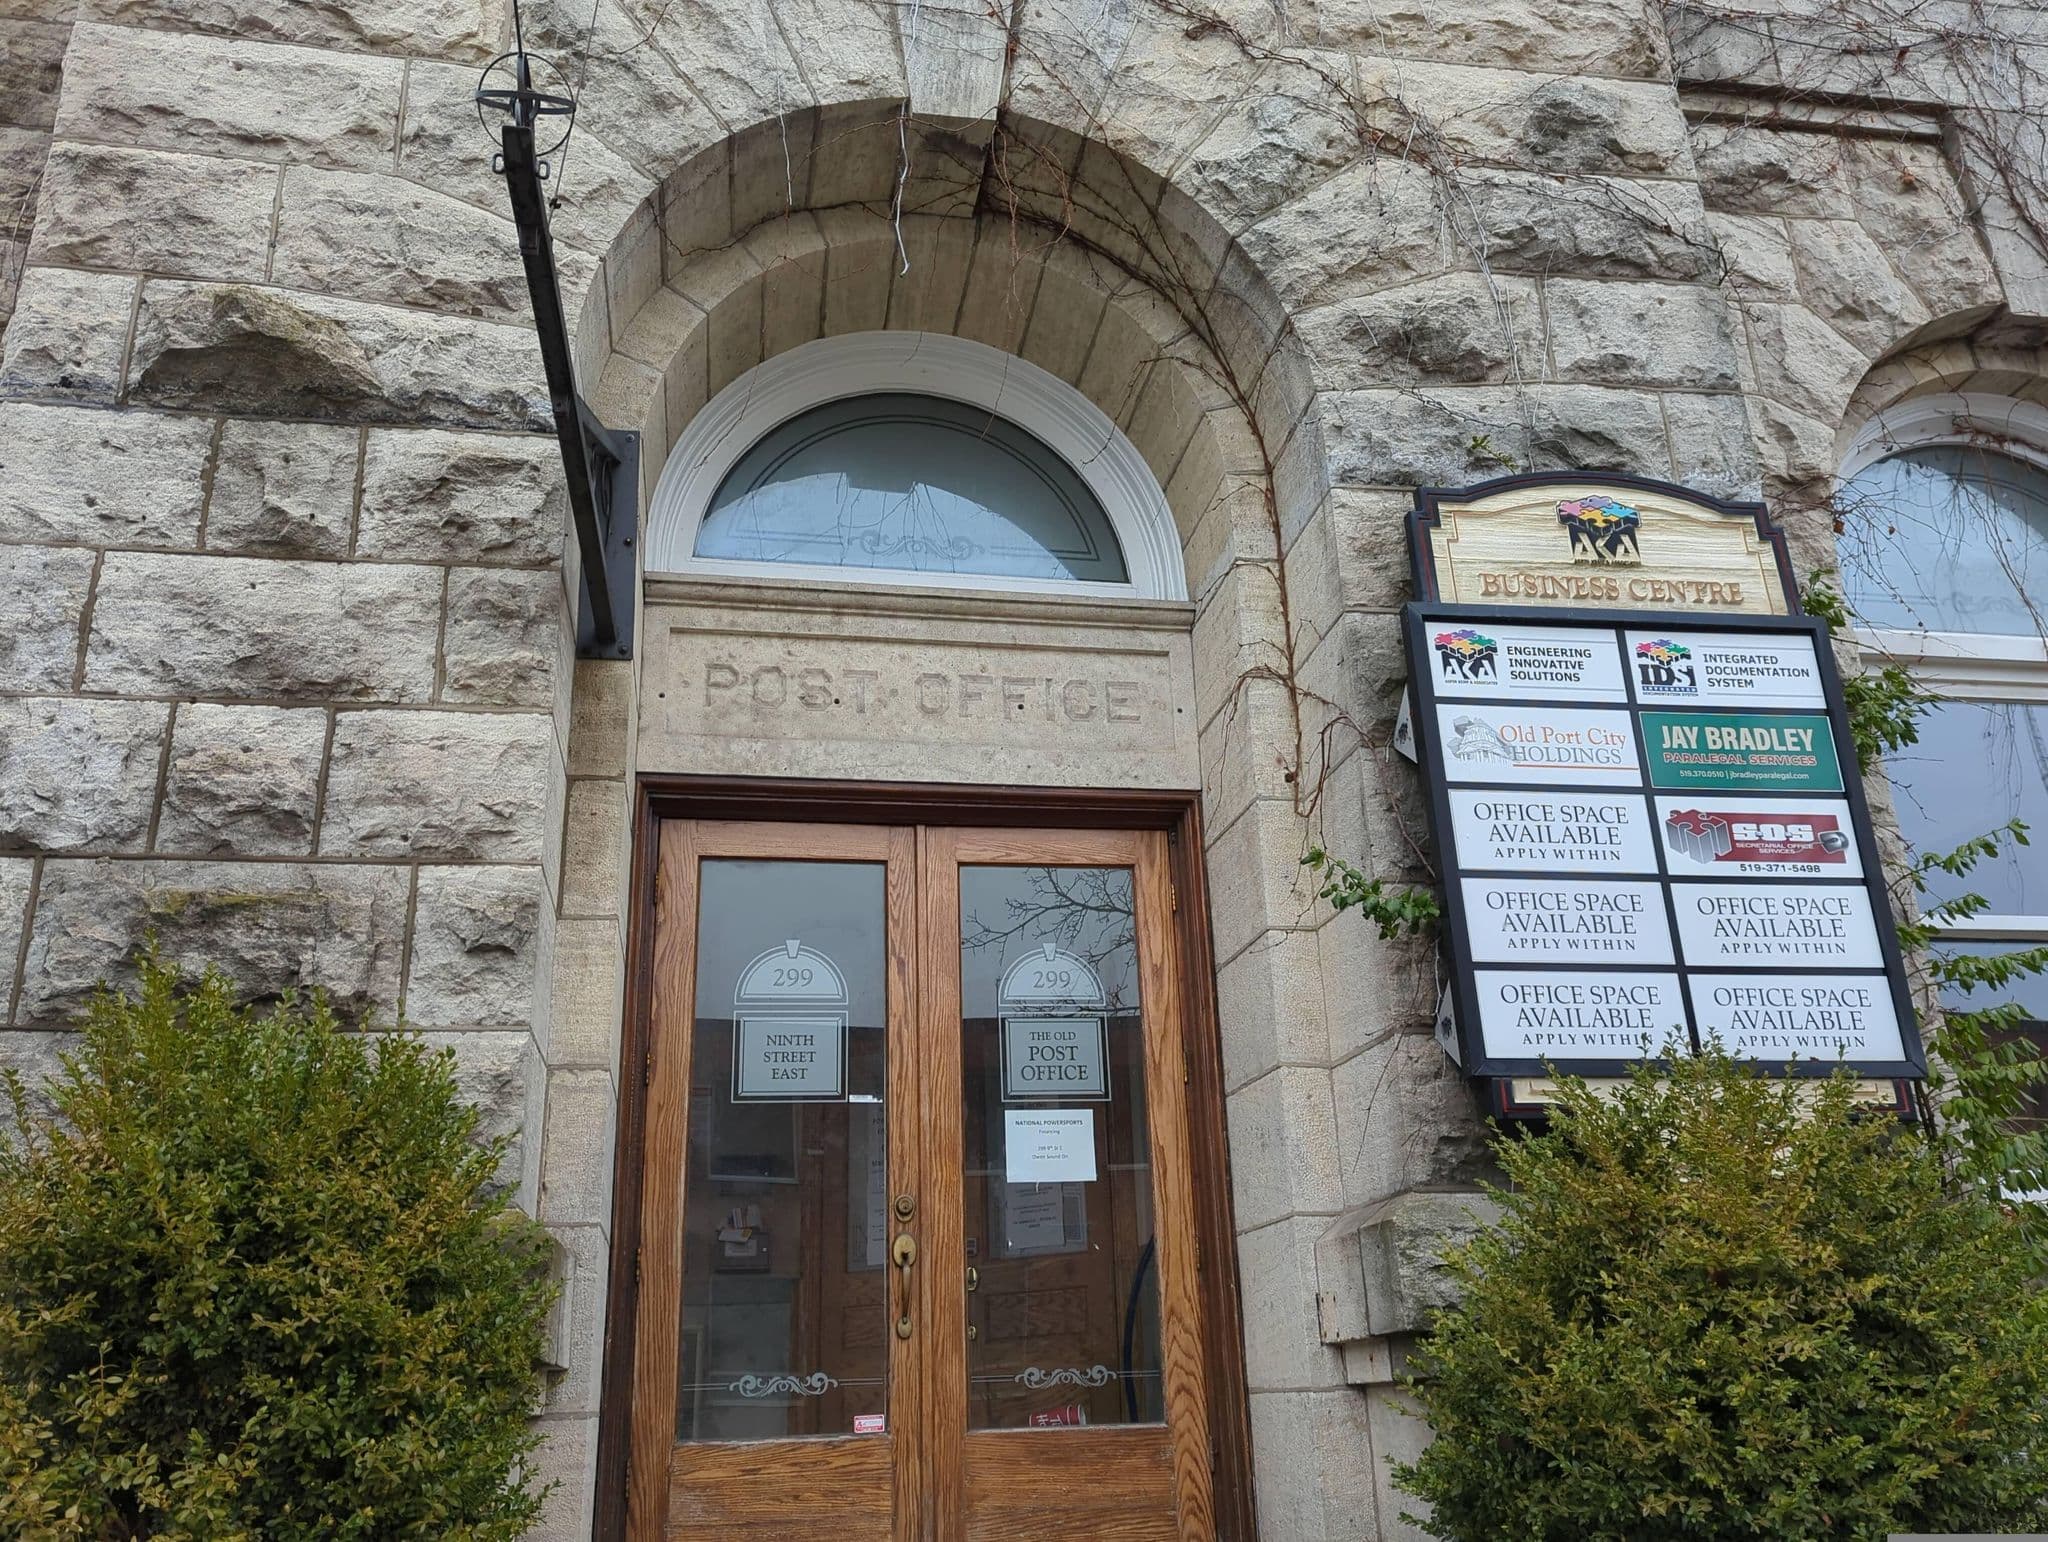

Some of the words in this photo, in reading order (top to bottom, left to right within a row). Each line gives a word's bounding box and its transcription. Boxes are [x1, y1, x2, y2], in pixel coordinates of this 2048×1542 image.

[1479, 572, 1620, 601] BUSINESS
[1628, 578, 1744, 605] CENTRE
[1506, 645, 1592, 659] ENGINEERING
[1703, 653, 1779, 665] INTEGRATED
[1508, 658, 1585, 671] INNOVATIVE
[1705, 665, 1810, 678] DOCUMENTATION
[1510, 670, 1581, 682] SOLUTIONS
[1638, 663, 1697, 687] IDS
[1707, 677, 1755, 689] SYSTEM
[704, 663, 878, 714] POST
[914, 672, 1141, 724] OFFICE
[1500, 725, 1536, 743] Old
[1541, 726, 1581, 745] Port
[1587, 728, 1627, 749] City
[1661, 725, 1699, 750] JAY
[1704, 726, 1814, 752] BRADLEY
[1512, 745, 1622, 765] HOLDINGS
[1663, 752, 1746, 765] PARALEGAL
[1749, 753, 1818, 767] SERVICES
[1473, 802, 1556, 822] OFFICE
[1560, 805, 1629, 825] SPACE
[1488, 824, 1622, 846] AVAILABLE
[1494, 848, 1548, 859] APPLY
[1552, 848, 1621, 861] WITHIN
[1736, 842, 1786, 850] SECRETARIAL
[1739, 863, 1821, 874] 519-371-5498
[1486, 891, 1570, 911] OFFICE
[1574, 893, 1645, 913] SPACE
[1697, 896, 1779, 916] OFFICE
[1783, 897, 1853, 916] SPACE
[1501, 913, 1637, 935] AVAILABLE
[1713, 918, 1847, 938] AVAILABLE
[1507, 937, 1562, 949] APPLY
[1567, 938, 1636, 951] WITHIN
[1720, 942, 1772, 954] APPLY
[1776, 942, 1846, 955] WITHIN
[773, 968, 814, 987] 299
[1032, 970, 1071, 989] 299
[1500, 984, 1585, 1005] OFFICE
[1589, 986, 1662, 1006] SPACE
[1713, 987, 1798, 1008] OFFICE
[1801, 988, 1873, 1008] SPACE
[1516, 1007, 1655, 1029] AVAILABLE
[1730, 1010, 1866, 1031] AVAILABLE
[766, 1034, 814, 1046] NINTH
[1029, 1031, 1052, 1041] THE
[1053, 1031, 1077, 1041] OLD
[1522, 1033, 1578, 1046] APPLY
[1583, 1033, 1654, 1046] WITHIN
[1737, 1035, 1791, 1047] APPLY
[1796, 1036, 1866, 1048] WITHIN
[763, 1051, 817, 1063] STREET
[1028, 1045, 1079, 1062] POST
[771, 1068, 808, 1080] EAST
[1021, 1064, 1089, 1081] OFFICE
